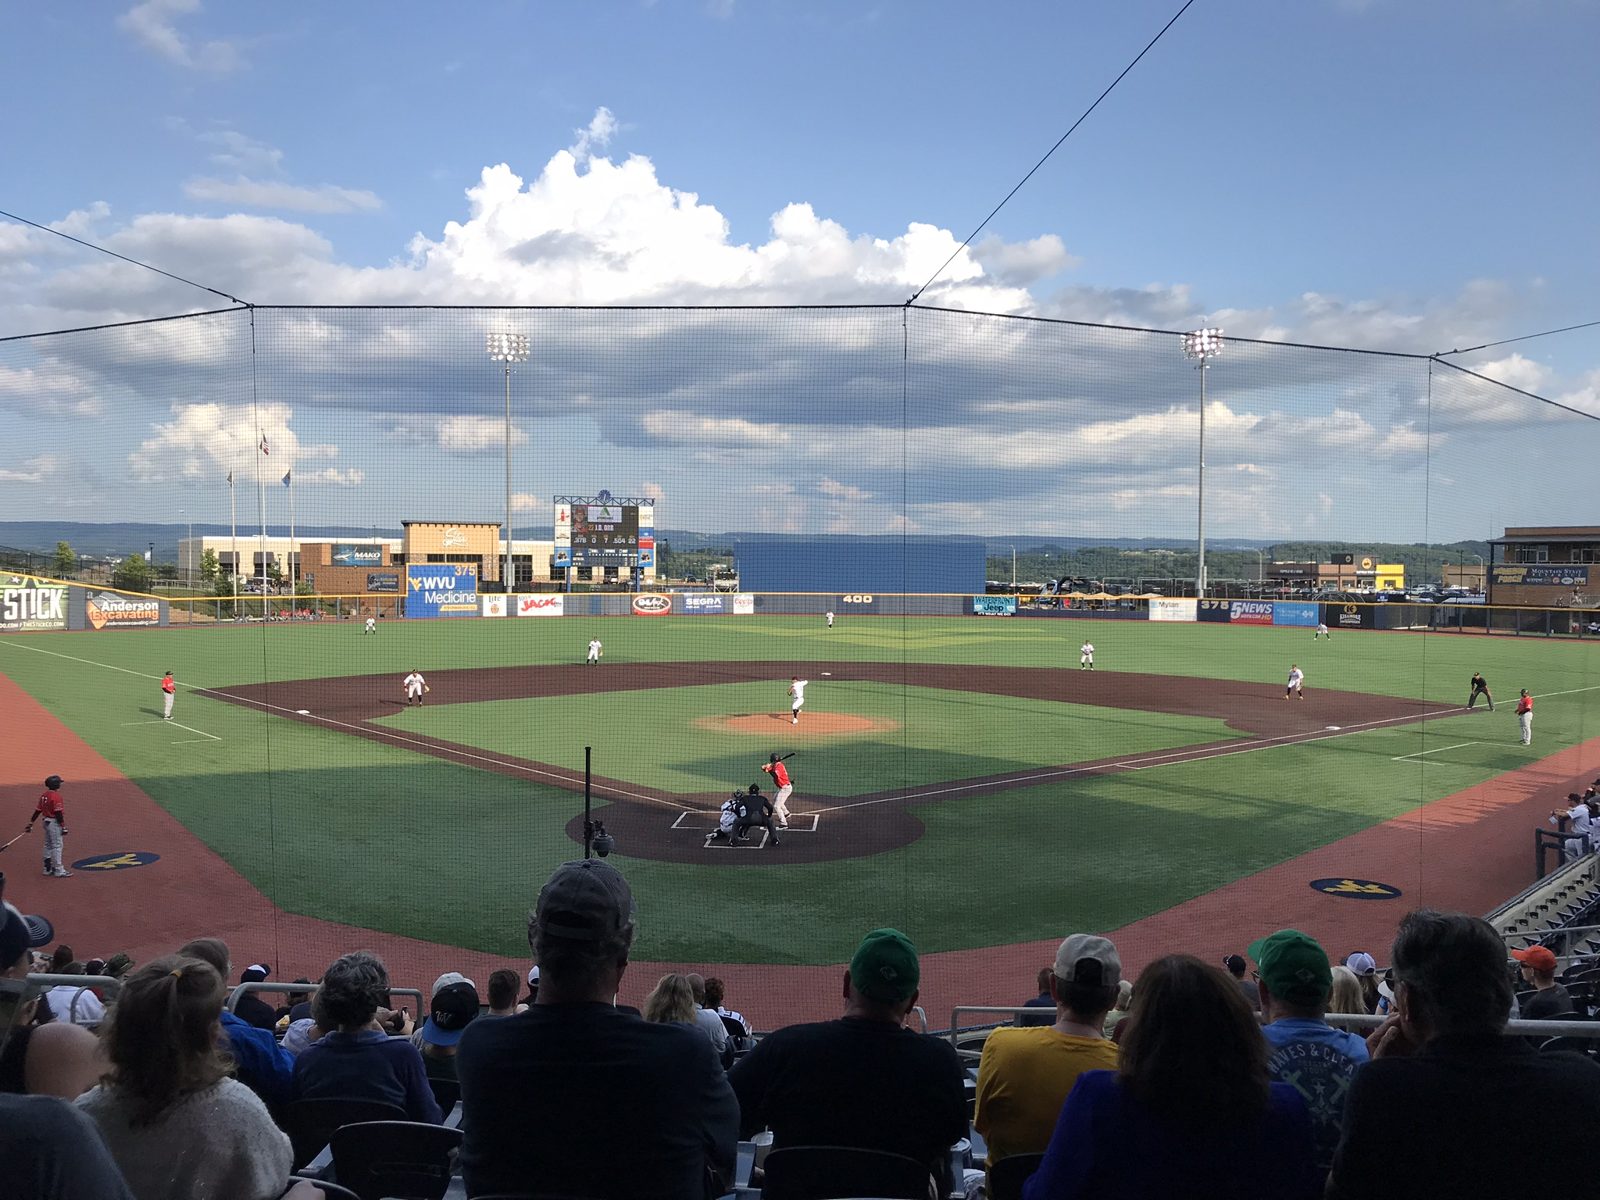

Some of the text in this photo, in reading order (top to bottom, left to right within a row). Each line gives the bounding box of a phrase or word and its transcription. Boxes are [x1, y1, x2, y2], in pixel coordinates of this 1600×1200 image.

[454, 565, 476, 576] 375
[423, 576, 456, 590] WVU
[425, 591, 476, 604] Medicine
[686, 598, 722, 606] SEGRA
[843, 595, 872, 603] 400
[102, 602, 159, 612] Anderson
[1201, 600, 1230, 610] 375
[92, 610, 159, 620] Excavating
[1230, 602, 1242, 619] 5
[1240, 602, 1273, 614] NEWS
[1310, 1043, 1320, 1056] &
